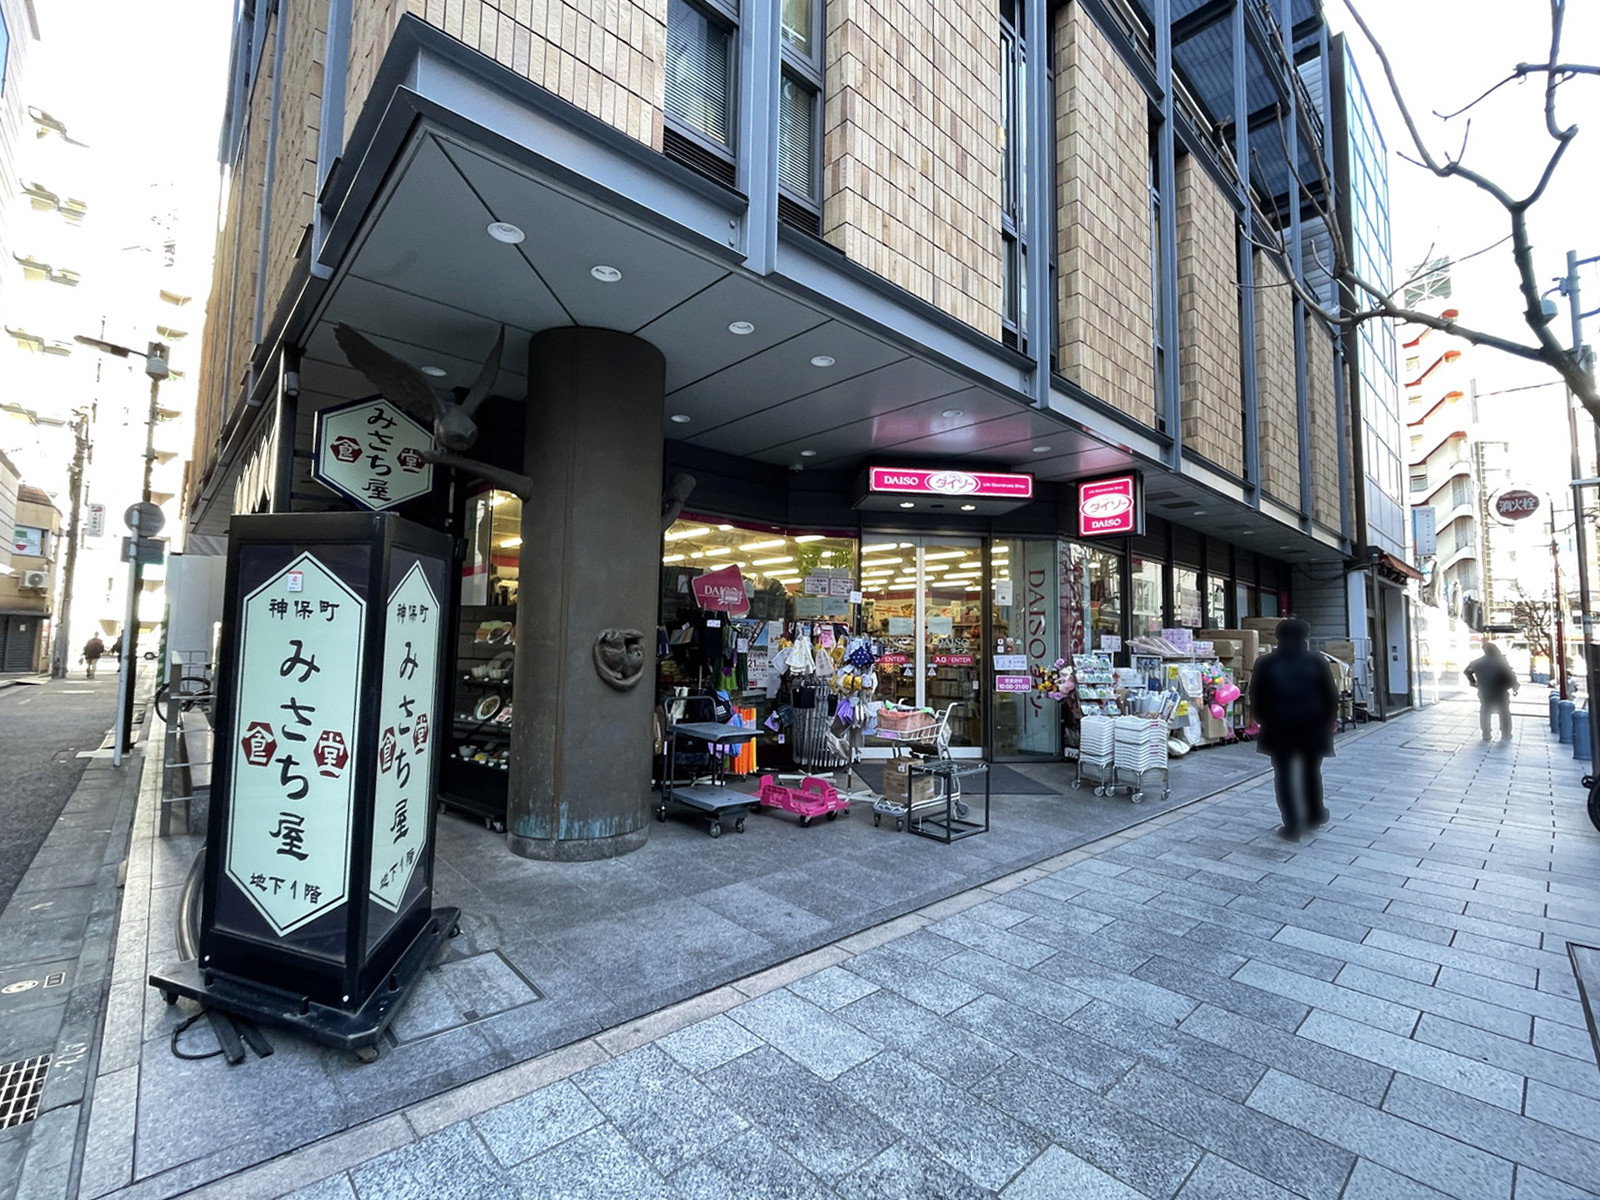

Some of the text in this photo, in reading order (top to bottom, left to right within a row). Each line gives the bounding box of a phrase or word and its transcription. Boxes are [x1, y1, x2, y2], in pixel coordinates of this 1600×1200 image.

[884, 475, 919, 486] DAISO
[935, 474, 974, 489] ダイソー
[1090, 498, 1127, 513] ダイソー
[1499, 497, 1536, 512] 消火栓
[1092, 518, 1121, 528] DAISO
[268, 598, 340, 621] 神保町
[397, 603, 429, 624] 神保町
[1028, 569, 1046, 659] DAISO
[269, 640, 321, 861] みさち屋
[390, 641, 419, 844] みさち屋
[250, 872, 322, 904] 地下1階
